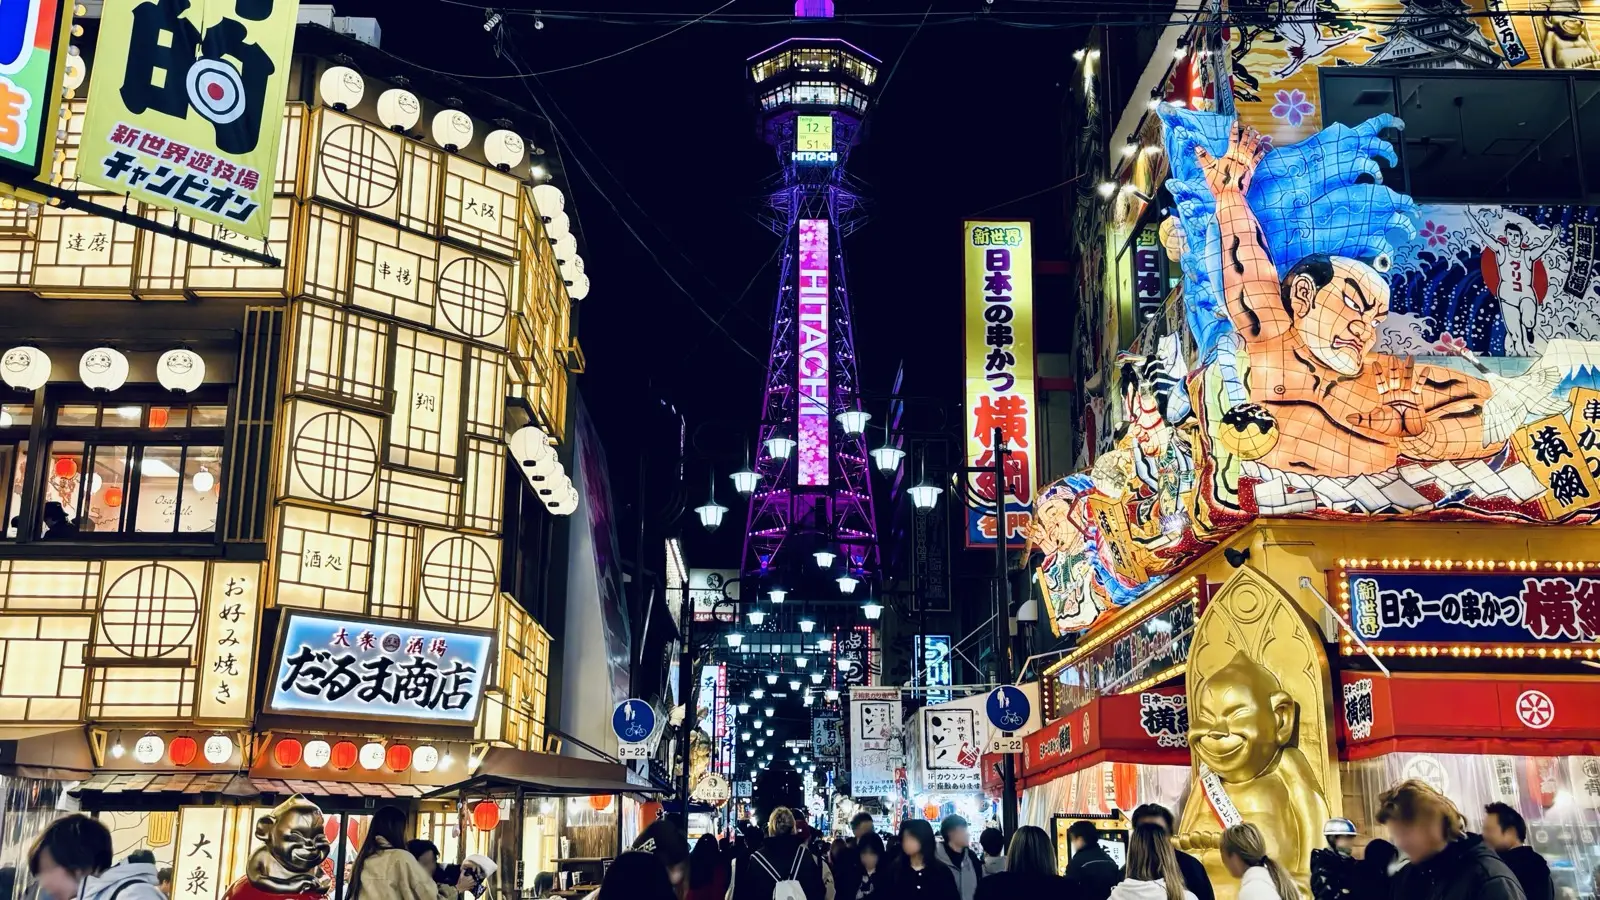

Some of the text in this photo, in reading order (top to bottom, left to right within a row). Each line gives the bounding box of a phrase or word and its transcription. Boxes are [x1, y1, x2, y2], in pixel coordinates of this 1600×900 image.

[118, 0, 276, 154] 的
[806, 123, 819, 132] 12
[807, 140, 819, 149] 51
[110, 124, 261, 191] 新世界遊技場
[791, 152, 838, 162] HITACHI
[103, 151, 259, 223] チャンピオン
[464, 197, 497, 221] 大阪
[66, 232, 109, 252] 達磨
[972, 227, 1023, 246] 新世界
[799, 268, 829, 415] HITACHI
[984, 249, 1016, 392] 日本一の串かつ
[415, 392, 436, 412] 翔
[973, 395, 1030, 504] 横綱
[304, 549, 344, 571] 酒処
[1356, 581, 1379, 636] 新世界
[1380, 591, 1520, 626] 日本一の串かつ
[214, 577, 246, 704] お好み焼き
[281, 646, 477, 711] だるま商店
[1345, 692, 1373, 728] 横綱
[186, 833, 213, 894] 大衆
